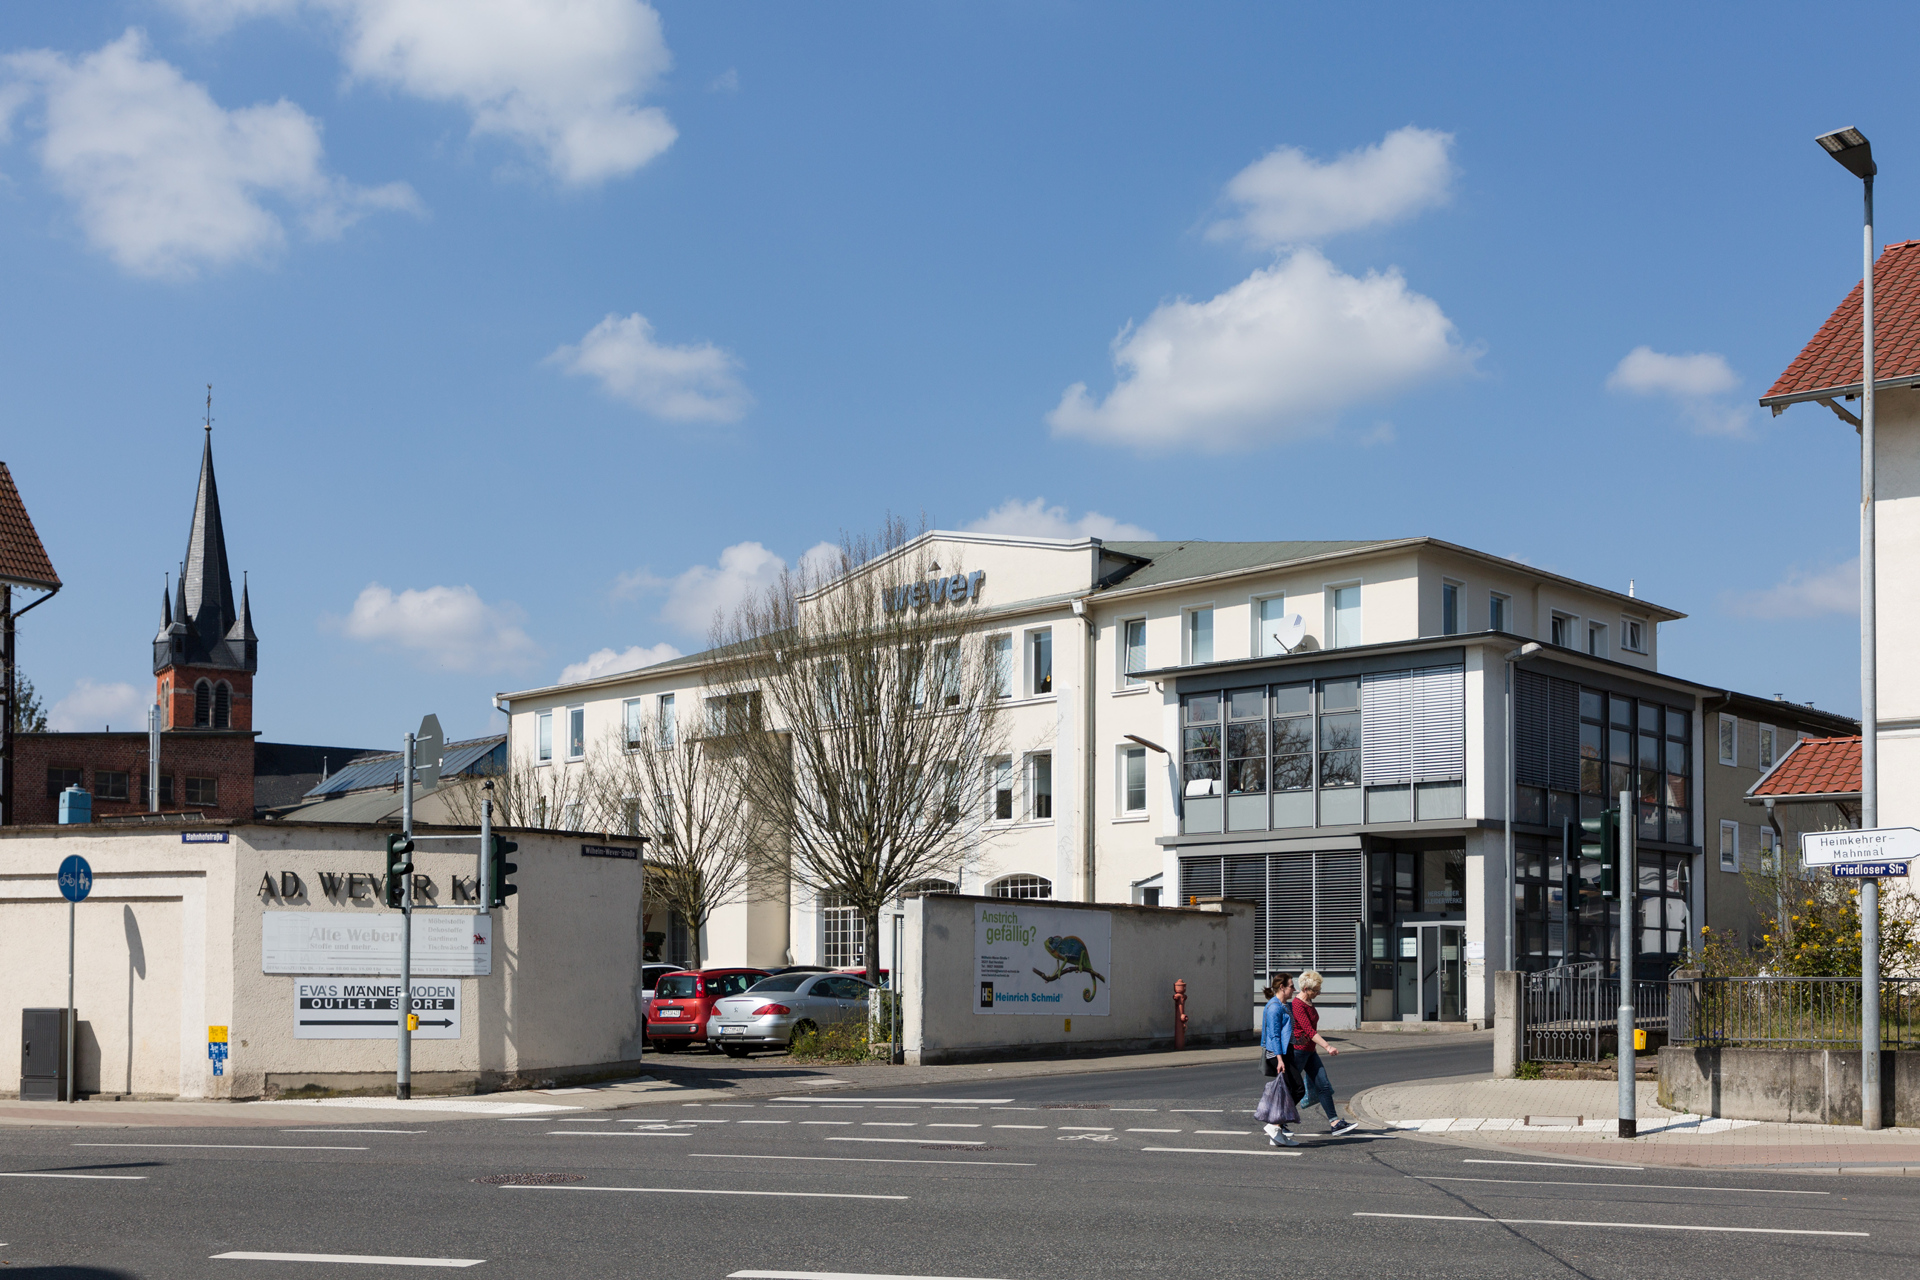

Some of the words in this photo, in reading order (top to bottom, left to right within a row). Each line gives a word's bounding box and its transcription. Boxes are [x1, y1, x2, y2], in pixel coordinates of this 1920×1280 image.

[1820, 835, 1895, 847] Heimkehrer-
[1833, 847, 1884, 859] Mahnmal
[1835, 864, 1886, 875] Friedloser
[1889, 863, 1904, 874] Str.
[257, 871, 304, 898] AD.
[316, 872, 434, 901] WEVR
[982, 910, 1018, 924] Anstrich
[310, 927, 342, 941] Alte
[347, 928, 402, 942] Weber
[986, 924, 1037, 947] gefällig?
[995, 992, 1029, 1002] Heinrich
[311, 998, 378, 1009] OUTLET
[389, 999, 444, 1010] SORE
